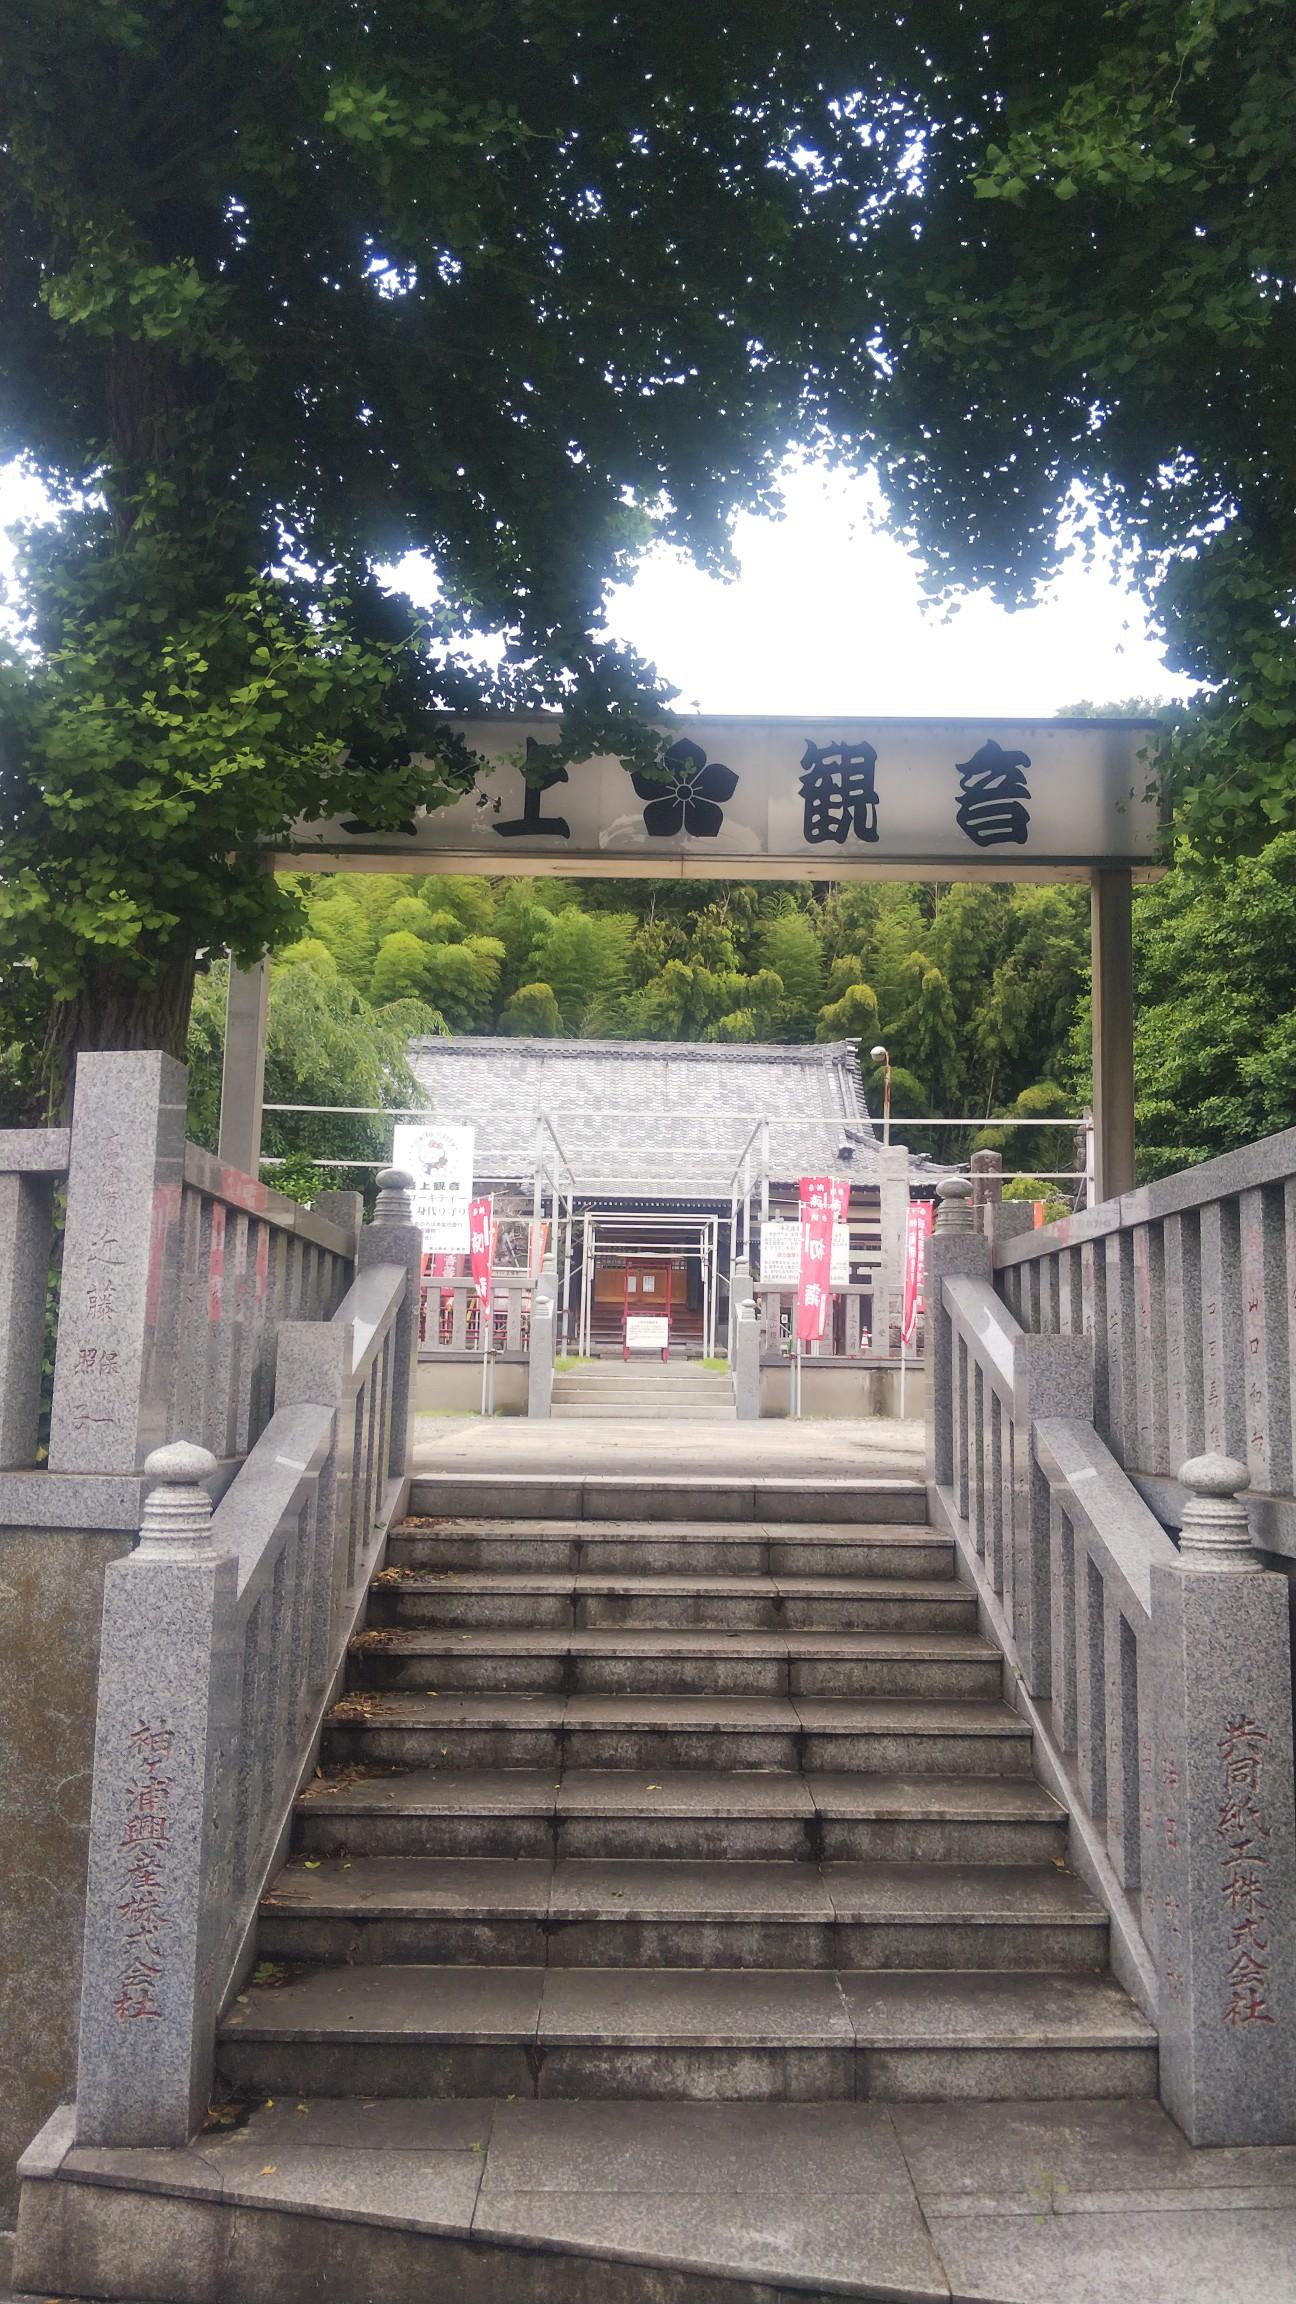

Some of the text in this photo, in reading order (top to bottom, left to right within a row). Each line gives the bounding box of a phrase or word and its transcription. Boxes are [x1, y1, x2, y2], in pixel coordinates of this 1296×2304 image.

[798, 737, 1032, 847] 観音
[87, 1229, 126, 1320] 近藤
[1216, 1713, 1278, 2026] 共同紙工株式会社
